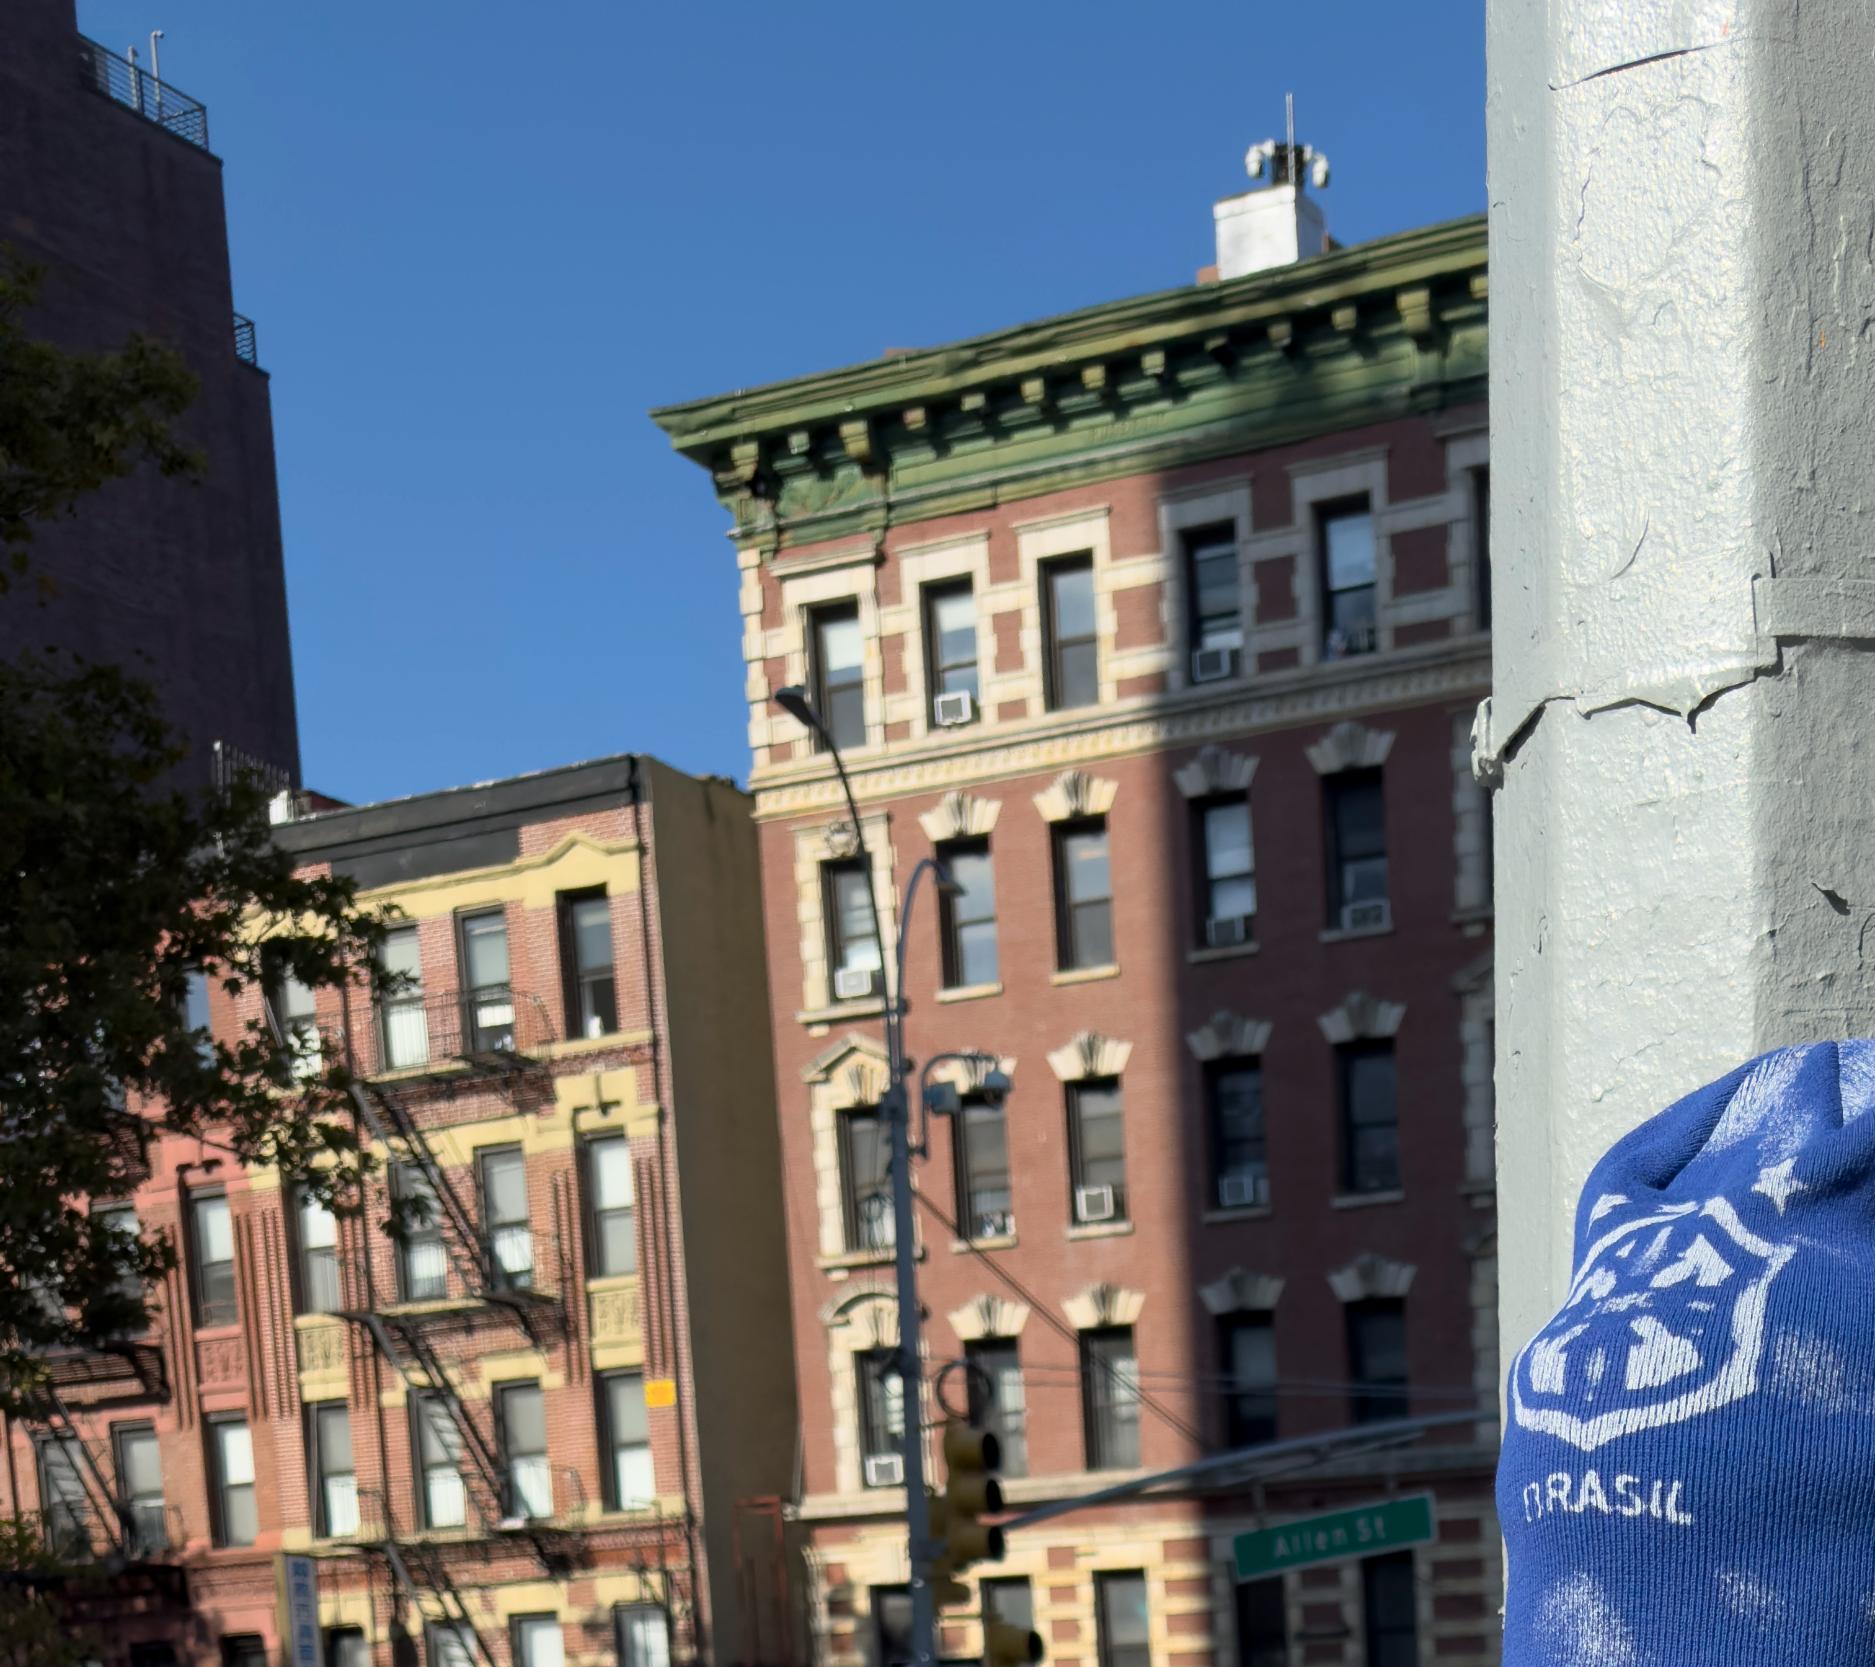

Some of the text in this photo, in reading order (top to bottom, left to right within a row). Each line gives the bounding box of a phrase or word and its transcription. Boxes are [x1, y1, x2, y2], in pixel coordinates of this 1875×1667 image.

[1523, 1469, 1693, 1526] BRASIL
[1274, 1514, 1386, 1558] Allen St
